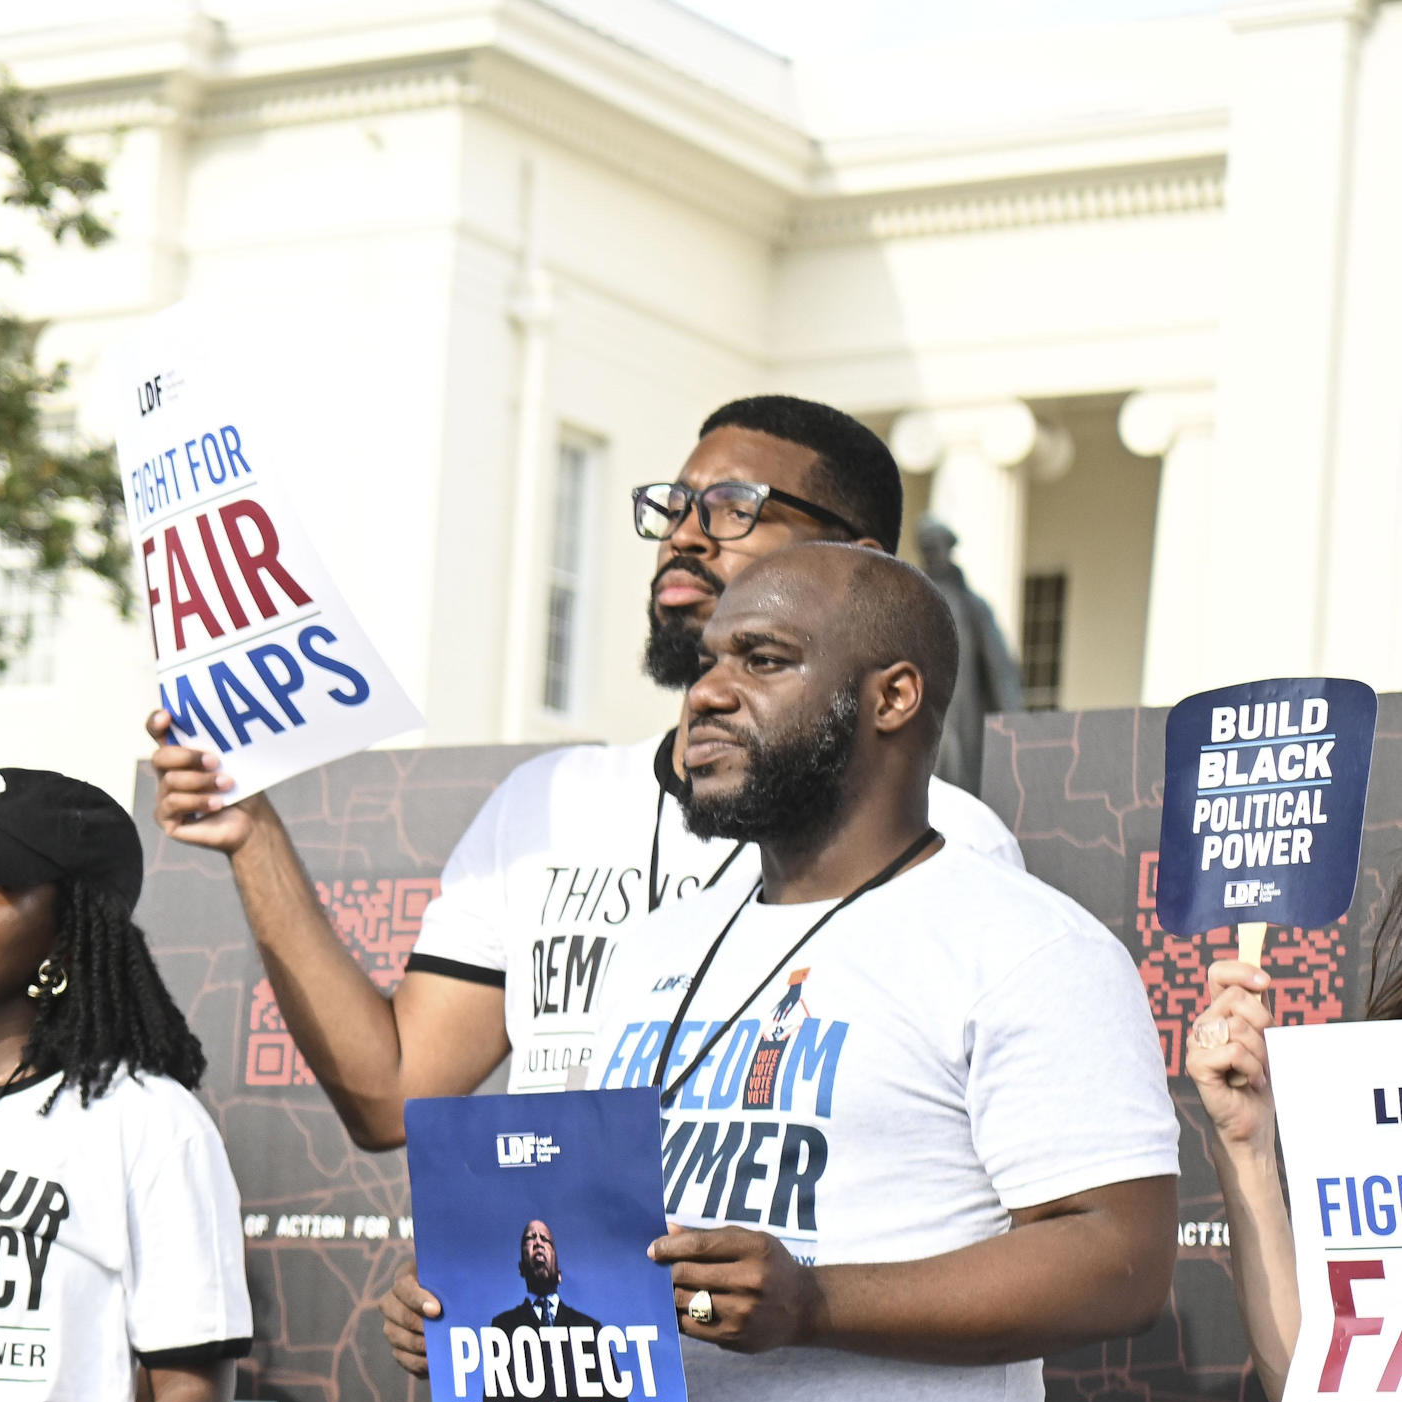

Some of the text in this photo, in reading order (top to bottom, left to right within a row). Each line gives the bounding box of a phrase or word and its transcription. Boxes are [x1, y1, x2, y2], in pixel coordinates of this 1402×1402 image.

[137, 374, 162, 417] LDF
[132, 424, 252, 523] FIGHT FOR
[142, 499, 314, 661] FAIR
[160, 625, 370, 753] MAPS
[1211, 698, 1329, 743] BUILD
[1198, 741, 1335, 789] BLACK
[1192, 789, 1328, 834] POLITICAL
[1201, 828, 1313, 871] POWER
[542, 868, 642, 925] THIS
[1224, 882, 1260, 904] LDF
[533, 935, 616, 1018] DEM
[753, 1063, 776, 1077] VOTE
[757, 1049, 780, 1063] VOTE
[747, 1089, 770, 1105] VOTE
[749, 1076, 772, 1090] VOTE
[497, 1136, 536, 1164] LDF
[661, 1118, 828, 1231] MMER
[276, 1214, 346, 1239] ACTION
[353, 1215, 391, 1239] FOR
[1316, 1175, 1402, 1238] FIG
[450, 1325, 658, 1398] PROTECT
